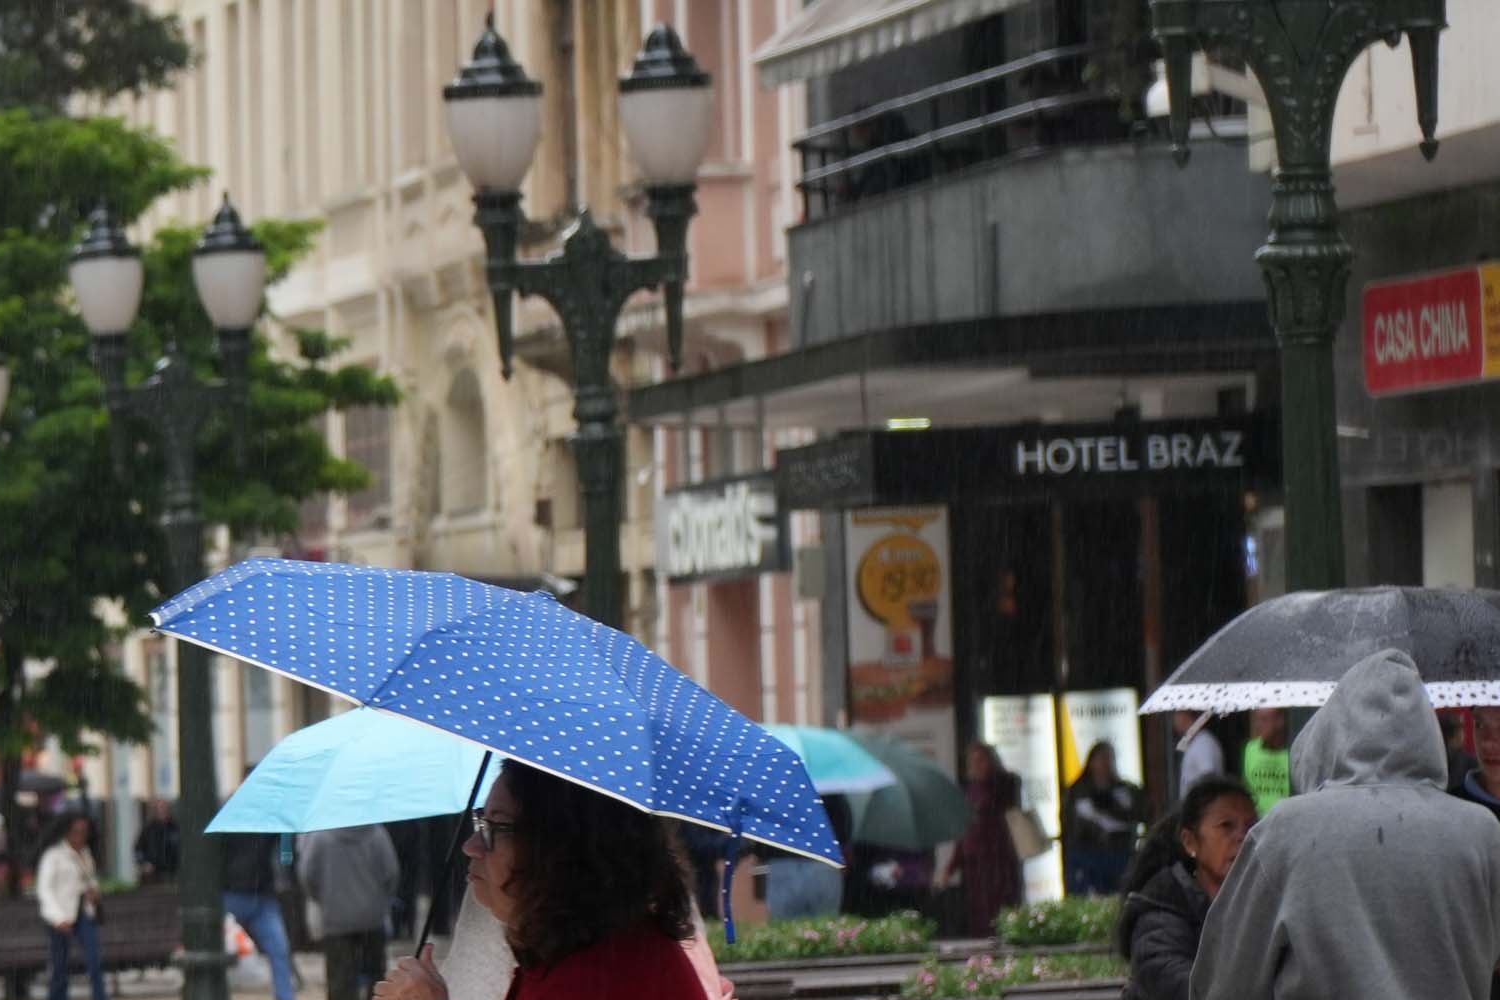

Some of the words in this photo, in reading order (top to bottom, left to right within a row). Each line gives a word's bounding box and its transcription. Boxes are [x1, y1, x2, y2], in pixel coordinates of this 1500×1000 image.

[1374, 308, 1417, 365] CASA
[1419, 298, 1470, 361] CHINA
[1016, 436, 1140, 475] HOTEL
[1147, 430, 1245, 470] BRAZ
